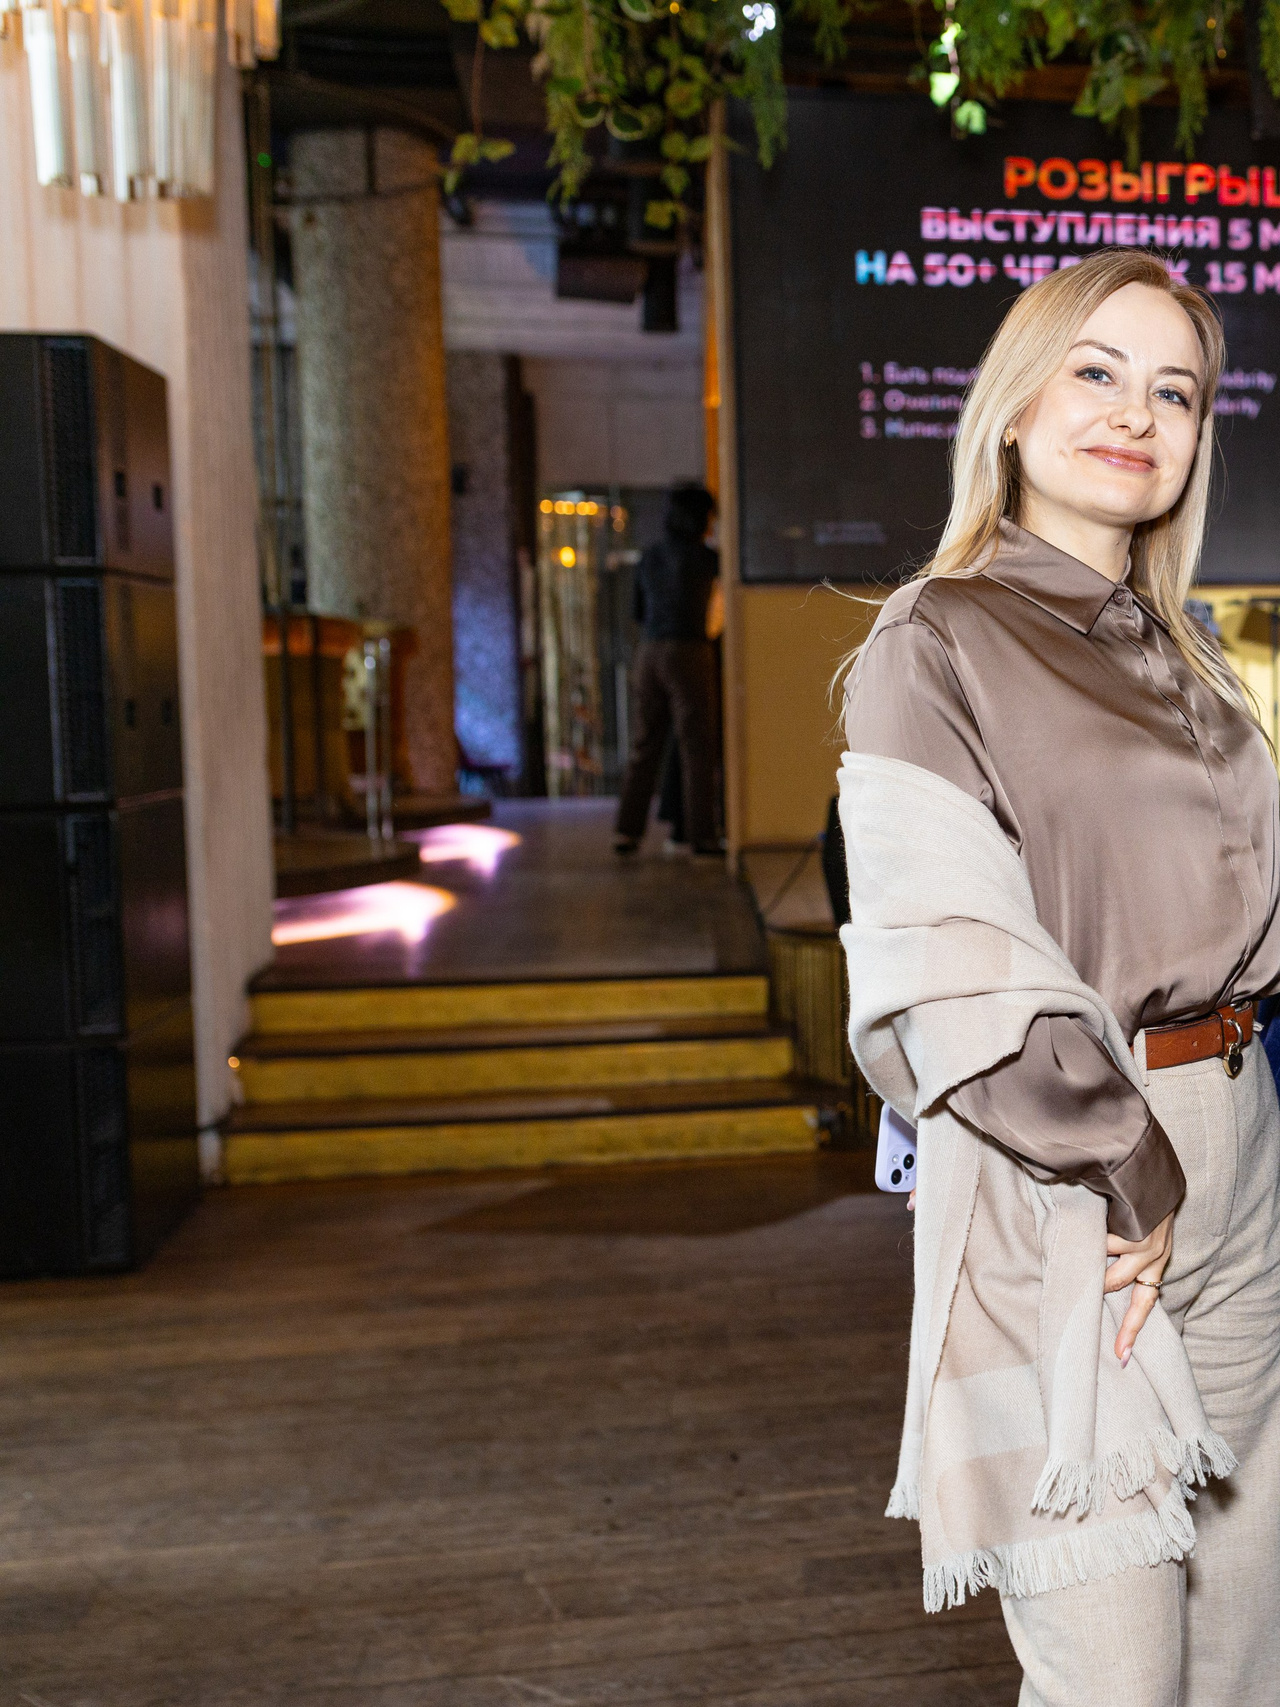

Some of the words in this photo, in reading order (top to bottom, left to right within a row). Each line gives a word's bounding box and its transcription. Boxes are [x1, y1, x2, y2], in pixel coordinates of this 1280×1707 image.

[919, 206, 1221, 250] ВЫСТУПЛЕНИЯ
[1227, 217, 1252, 250] 5
[855, 250, 918, 286] НА
[923, 252, 997, 287] 50+
[1205, 260, 1247, 294] 15
